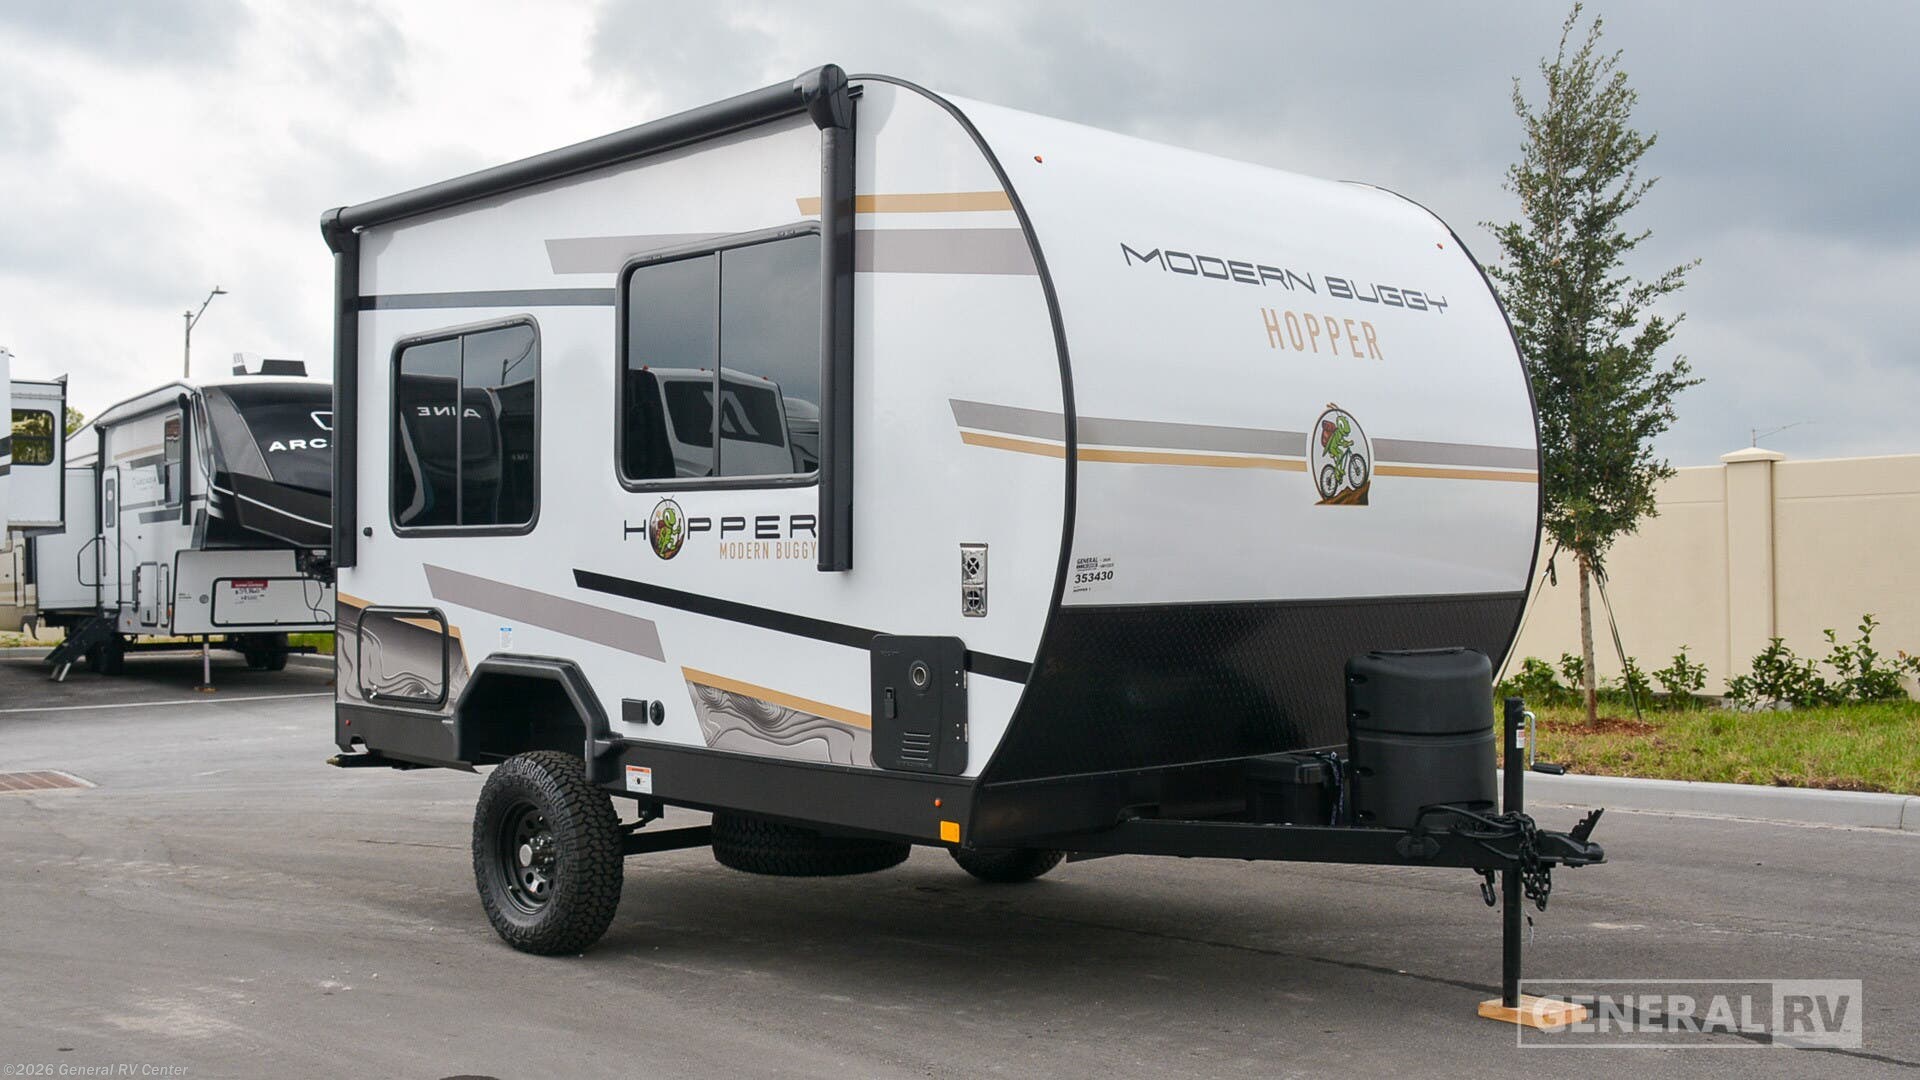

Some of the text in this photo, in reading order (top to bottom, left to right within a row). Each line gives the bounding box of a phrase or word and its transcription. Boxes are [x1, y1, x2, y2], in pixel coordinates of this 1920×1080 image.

[1120, 242, 1448, 314] MODERN BUGGY
[1261, 307, 1384, 361] HOPPER
[268, 438, 334, 452] ARC
[719, 541, 817, 560] MODERN BUGGY
[1074, 571, 1113, 583] 353430
